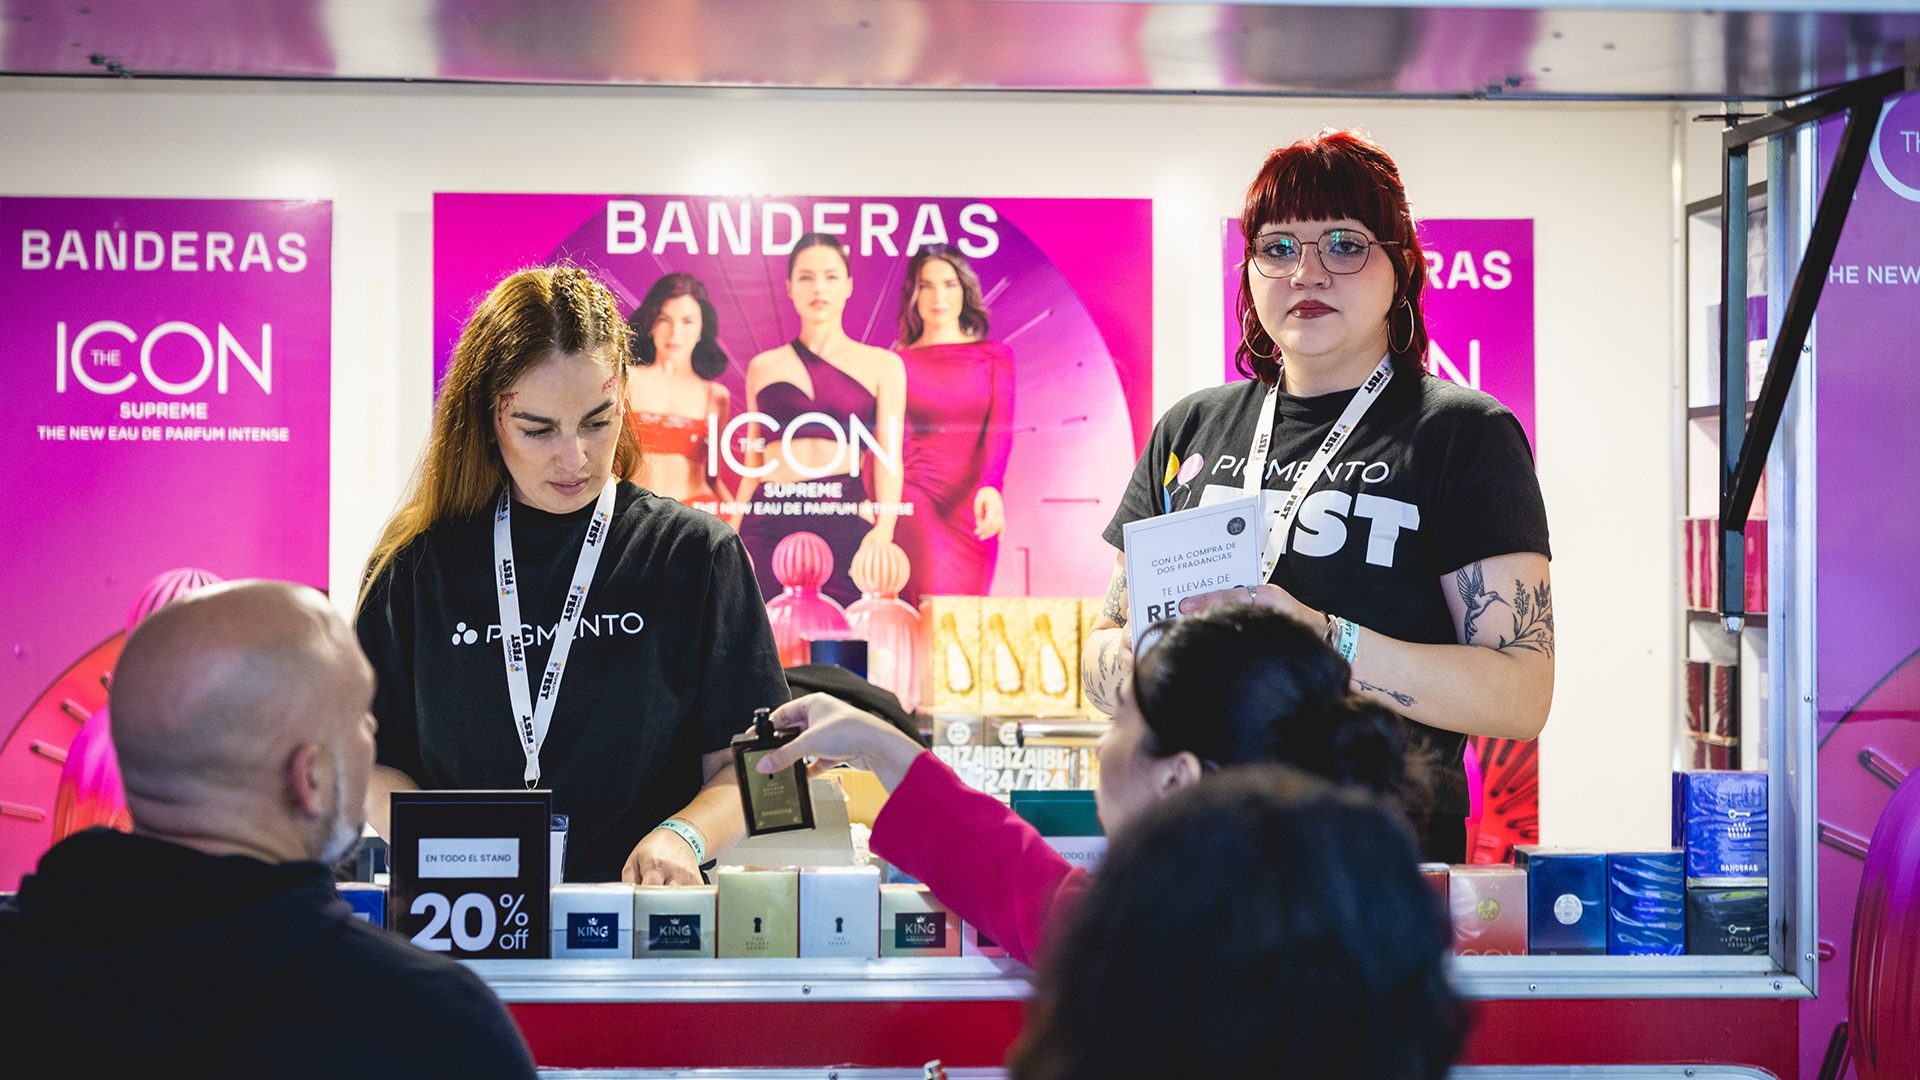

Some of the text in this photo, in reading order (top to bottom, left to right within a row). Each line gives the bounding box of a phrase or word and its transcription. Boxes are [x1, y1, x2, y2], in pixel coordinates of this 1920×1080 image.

[606, 200, 1000, 258] BANDERAS
[21, 229, 308, 273] BANDERAS
[1829, 265, 1920, 284] HE NEW
[56, 320, 272, 395] ICON
[90, 349, 121, 366] THE
[1364, 370, 1384, 394] FEST
[119, 402, 208, 419] SUPREME
[37, 425, 290, 442] THE NEW EAU DE PARFUM INTENSE
[707, 411, 900, 479] ICON
[738, 437, 767, 453] THE
[1257, 433, 1270, 454] FEST
[1321, 431, 1341, 454] FEST
[1211, 455, 1390, 484] PIMENTO
[763, 482, 843, 498] SUPREME
[692, 501, 914, 515] THE NEW EAU DE PARFUM INTENSE
[1280, 494, 1298, 520] FEST
[586, 519, 601, 547] FEST
[1151, 541, 1237, 568] CON LA COMPRA DE
[1156, 552, 1232, 575] DOS FRAGANCIAS
[502, 558, 514, 585] FEST
[1162, 573, 1231, 597] TE LLEVÁS DE
[564, 594, 578, 622] FEST
[486, 612, 644, 647] PGMNTO
[510, 634, 523, 662] FEST
[540, 671, 555, 700] FEST
[522, 714, 534, 744] FEST
[425, 853, 512, 863] EN TODO EL STAND
[499, 928, 529, 950] off
[577, 925, 609, 938] KING
[659, 925, 691, 937] KING
[905, 923, 936, 935] KING
